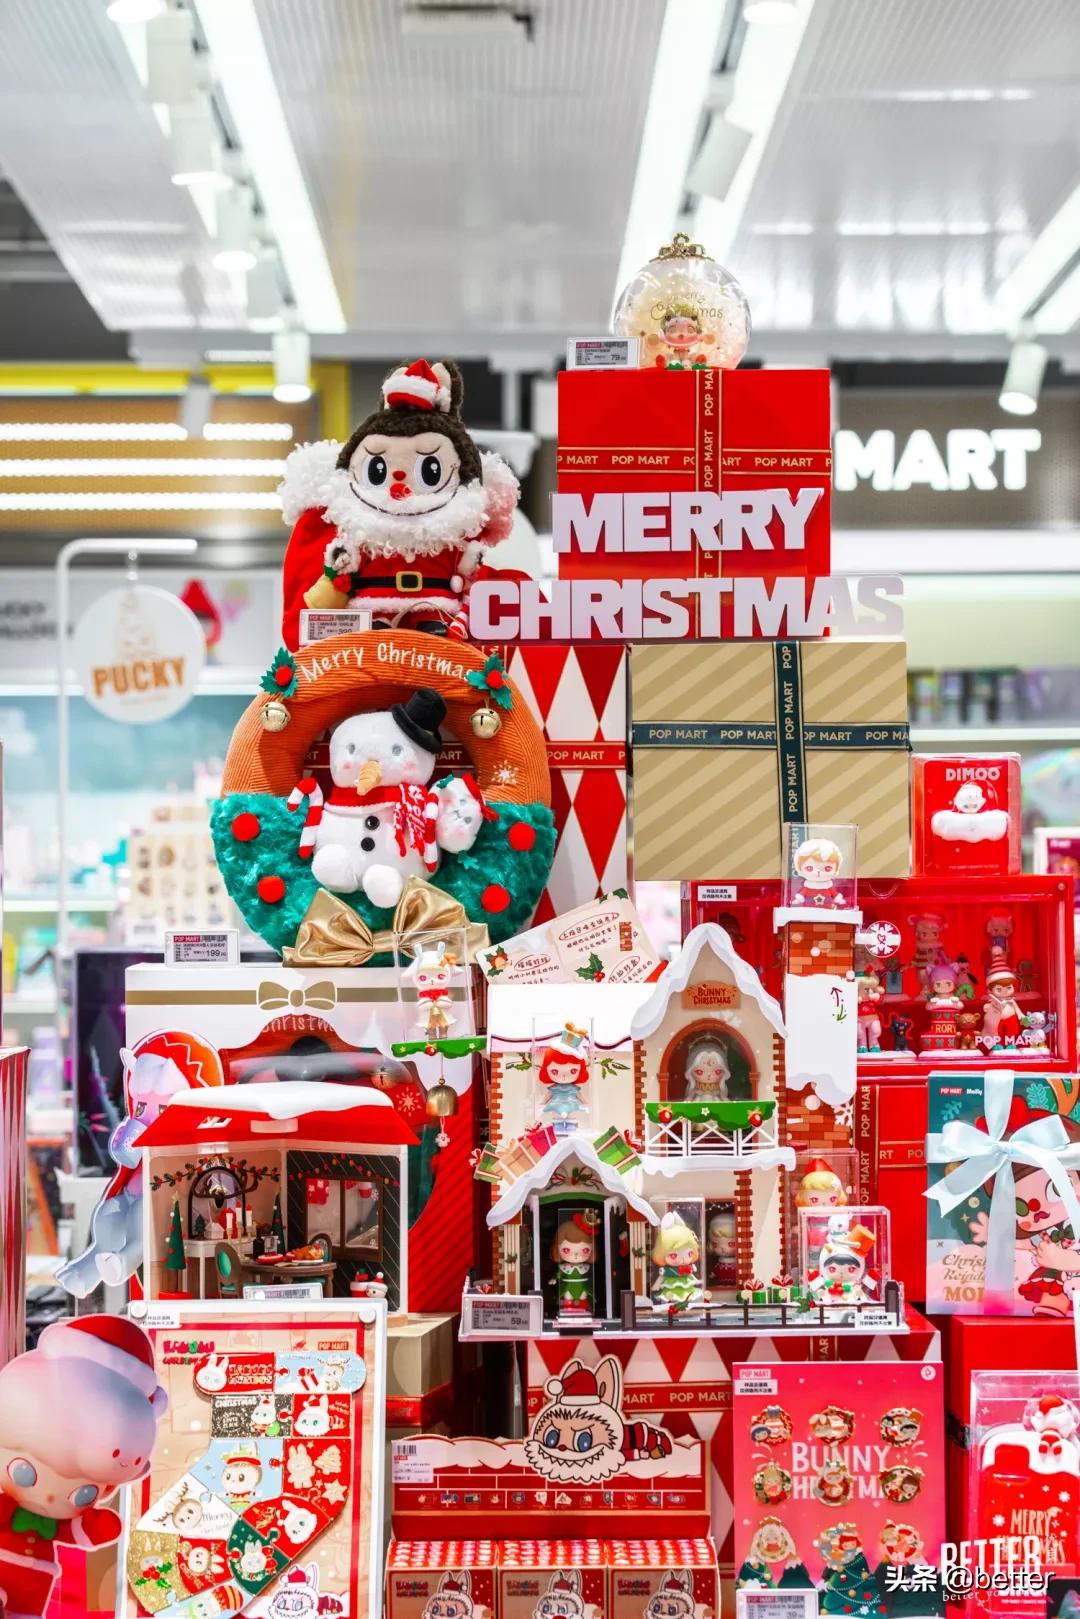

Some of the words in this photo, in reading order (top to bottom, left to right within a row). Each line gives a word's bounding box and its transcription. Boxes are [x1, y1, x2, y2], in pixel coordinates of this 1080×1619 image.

[704, 369, 714, 390] MA
[704, 395, 714, 416] POP
[704, 429, 714, 465] MART
[566, 455, 599, 465] MART
[611, 455, 634, 465] POP
[638, 455, 670, 465] MART
[721, 456, 741, 466] ART
[754, 457, 777, 466] POP
[781, 457, 813, 467] MART
[833, 429, 1042, 491] MART
[704, 467, 714, 488] POP
[552, 488, 824, 553] MERRY
[469, 575, 905, 641] CHRISTMAS
[300, 646, 364, 683] Merry
[376, 642, 474, 682] Christmas
[783, 646, 793, 669] POP
[92, 656, 185, 698] PUCKY
[784, 681, 794, 714] MART
[649, 730, 672, 739] POP
[675, 730, 708, 739] MART
[720, 730, 743, 740] POP
[785, 717, 795, 740] POP
[819, 731, 852, 741] MART
[865, 731, 888, 741] POP
[892, 731, 909, 741] MA
[547, 751, 569, 761] POP
[572, 751, 605, 761] MART
[788, 754, 796, 786] MART
[945, 767, 1001, 781] DIMOO
[788, 790, 798, 813] POP
[693, 995, 731, 1005] CHRISTMAS
[697, 986, 727, 997] BUNNY
[935, 1023, 957, 1034] RORY
[975, 1035, 1002, 1047] POP
[1005, 1035, 1041, 1046] MART
[861, 1085, 871, 1110] MAR
[966, 1088, 983, 1096] Molly
[861, 1114, 870, 1138] POP
[880, 1150, 894, 1160] RT
[907, 1149, 924, 1158] PO
[860, 1151, 870, 1181] MART
[860, 1188, 870, 1206] OP
[622, 1393, 655, 1403] MART
[669, 1392, 694, 1403] POP
[791, 1442, 891, 1473] BUNNY
[1010, 1508, 1052, 1537] MERRY
